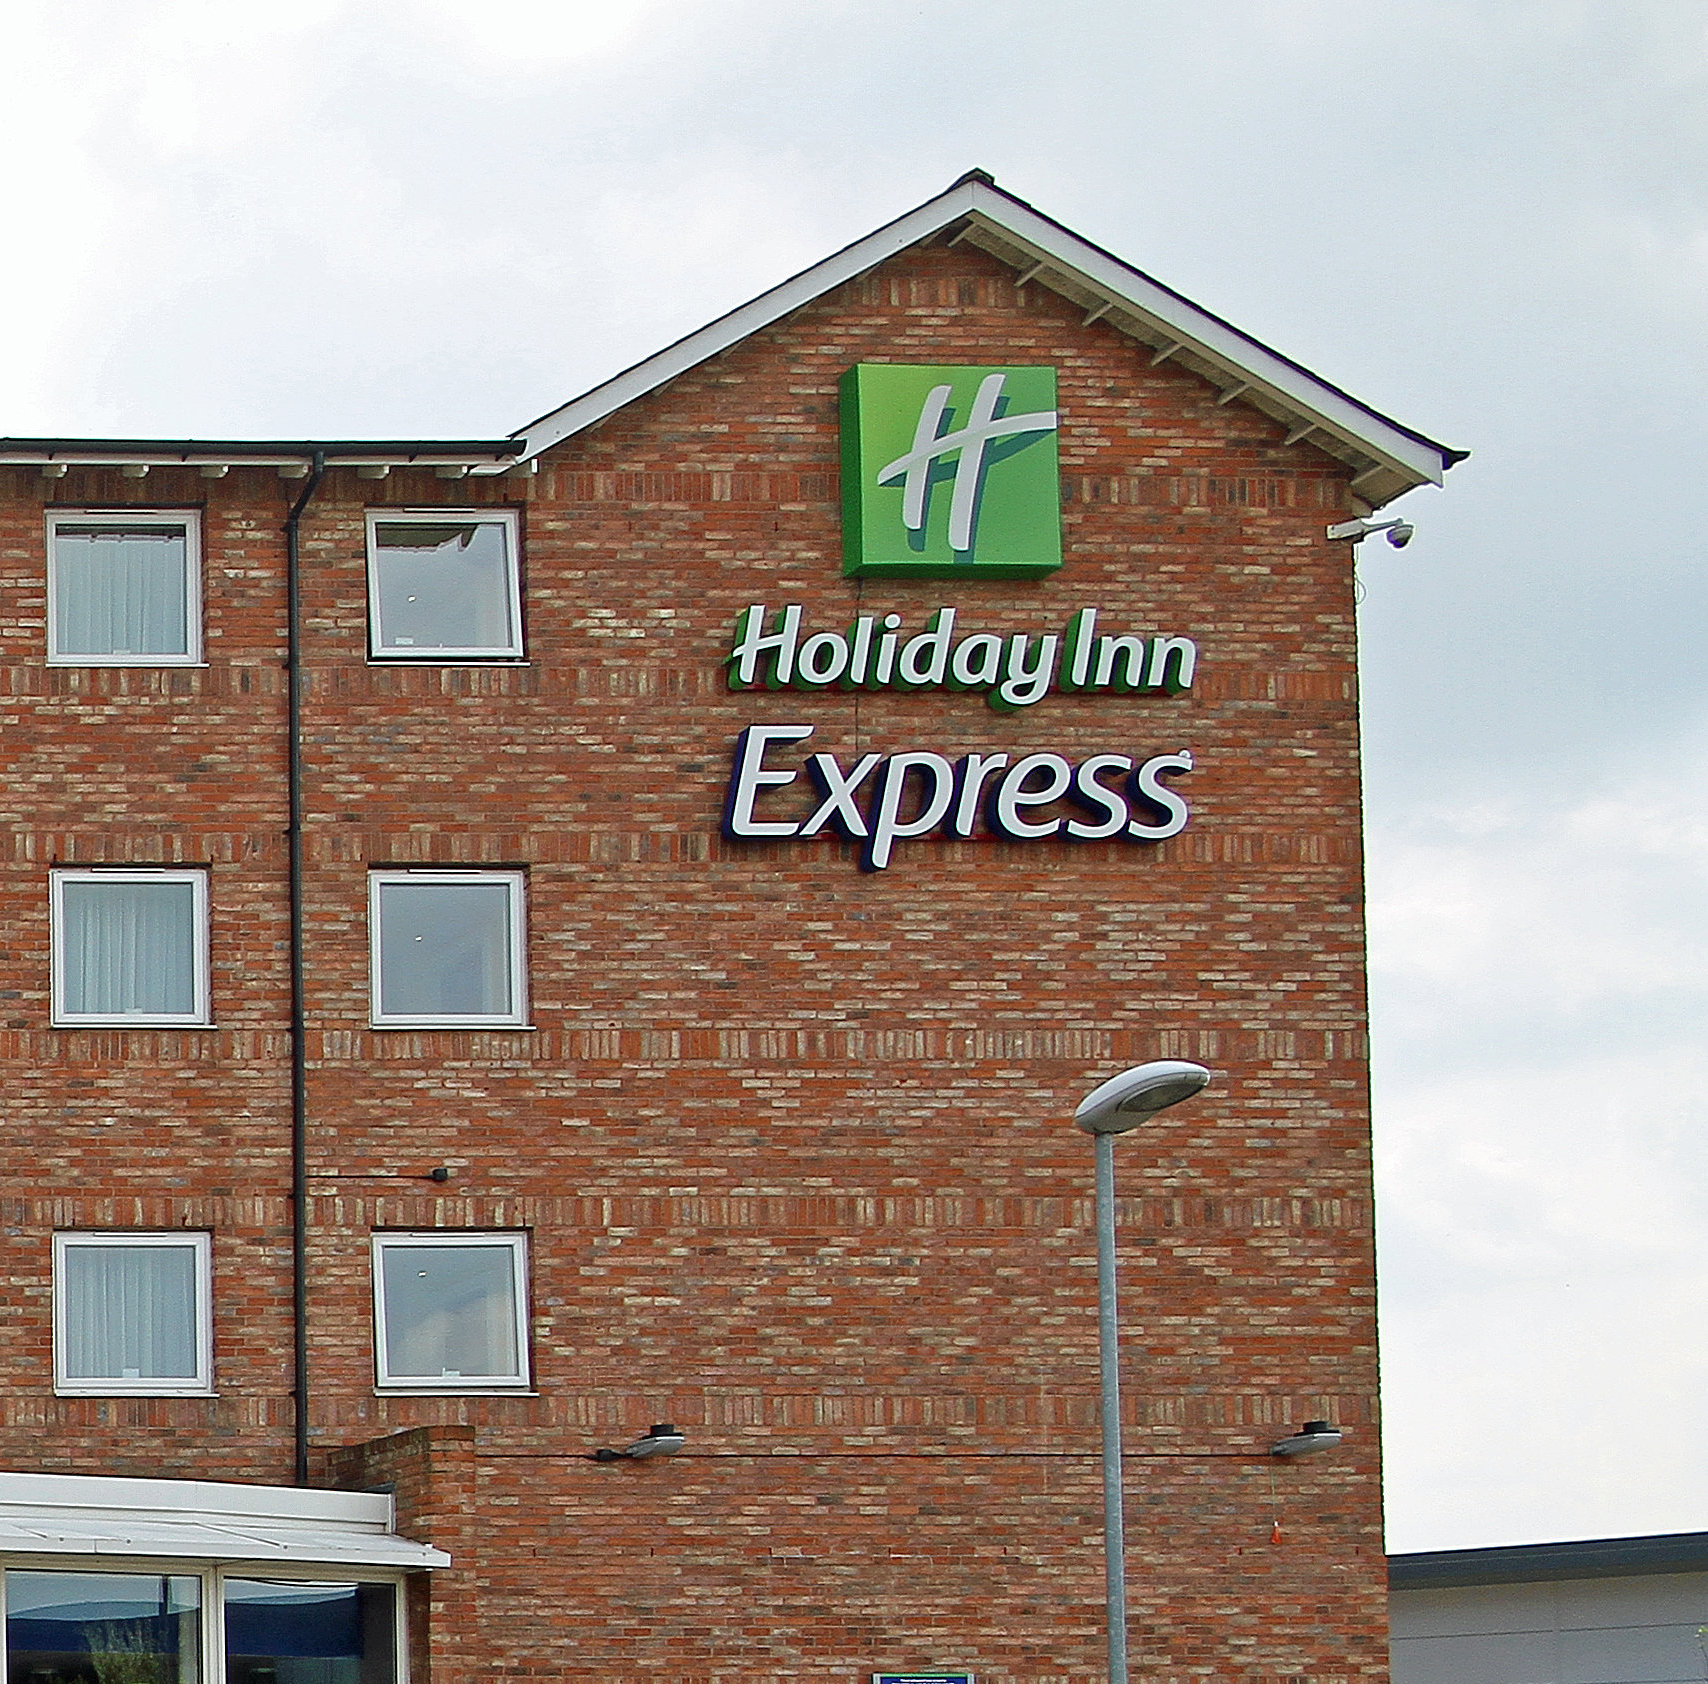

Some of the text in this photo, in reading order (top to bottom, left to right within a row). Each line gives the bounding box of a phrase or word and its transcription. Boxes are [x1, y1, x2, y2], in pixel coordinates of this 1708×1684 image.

[730, 604, 1196, 708] Holiday Inn
[730, 725, 1193, 870] Express
